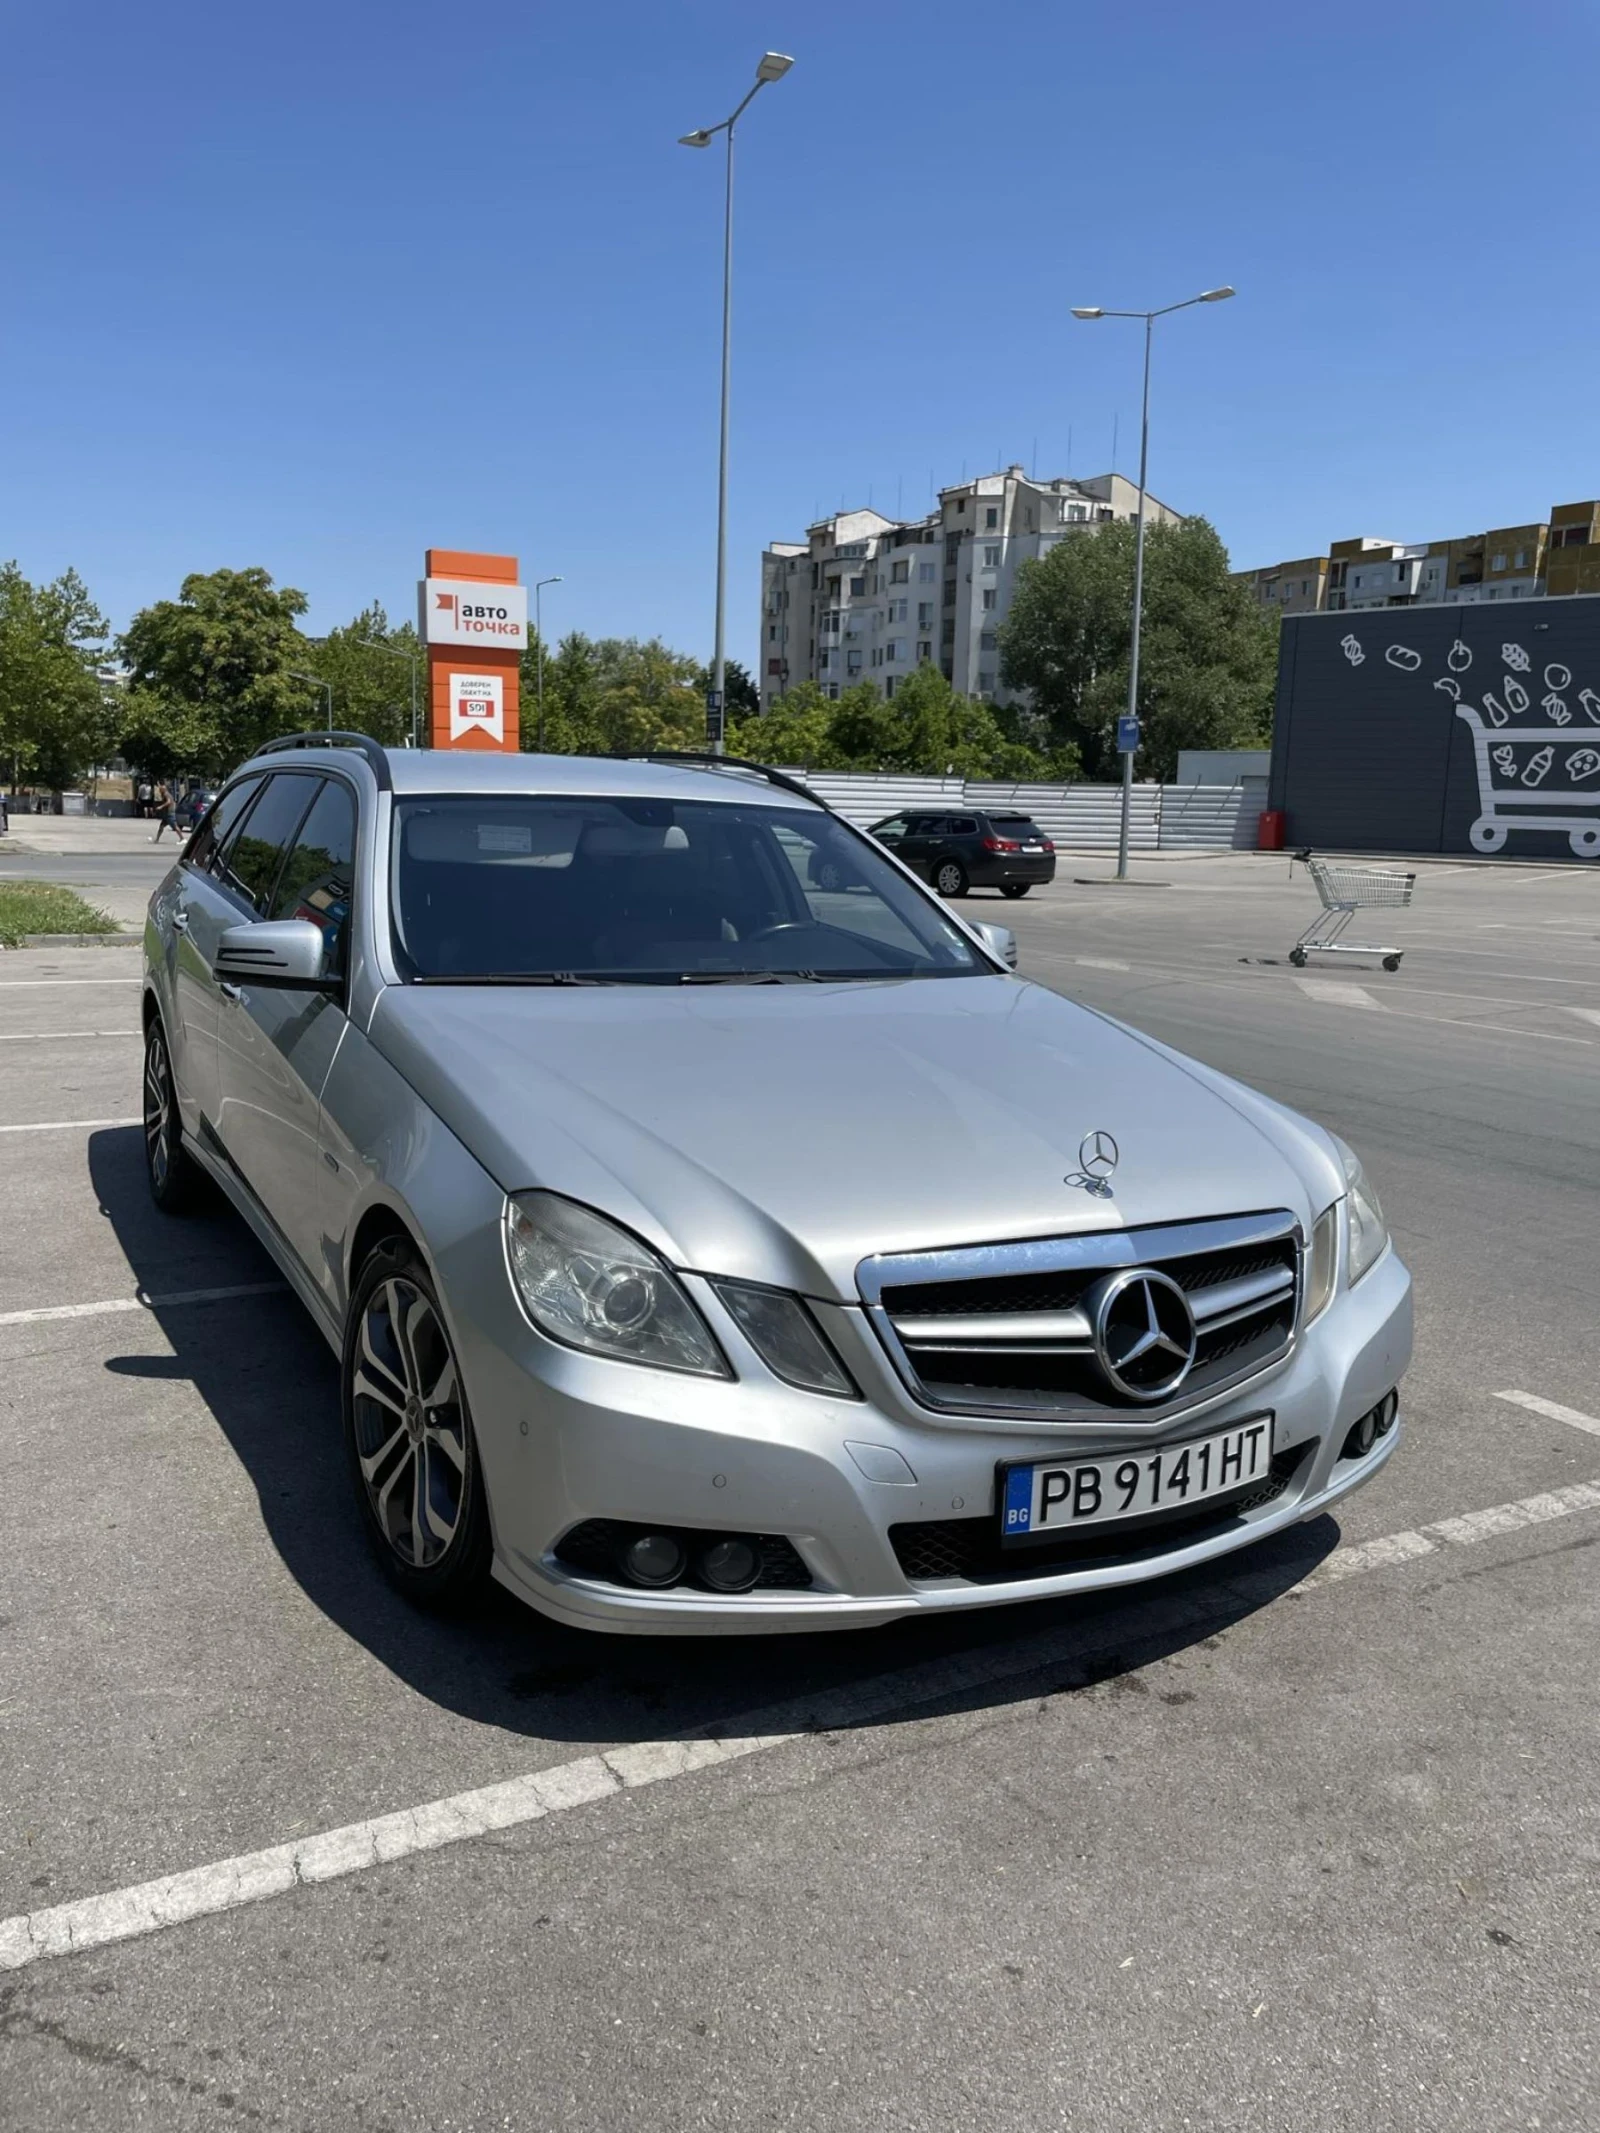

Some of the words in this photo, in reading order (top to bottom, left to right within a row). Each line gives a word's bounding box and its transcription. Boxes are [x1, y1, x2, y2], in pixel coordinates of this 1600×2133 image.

[462, 605, 507, 620] авто
[463, 620, 520, 635] точка
[469, 703, 485, 712] SDI
[1007, 1508, 1029, 1525] BG
